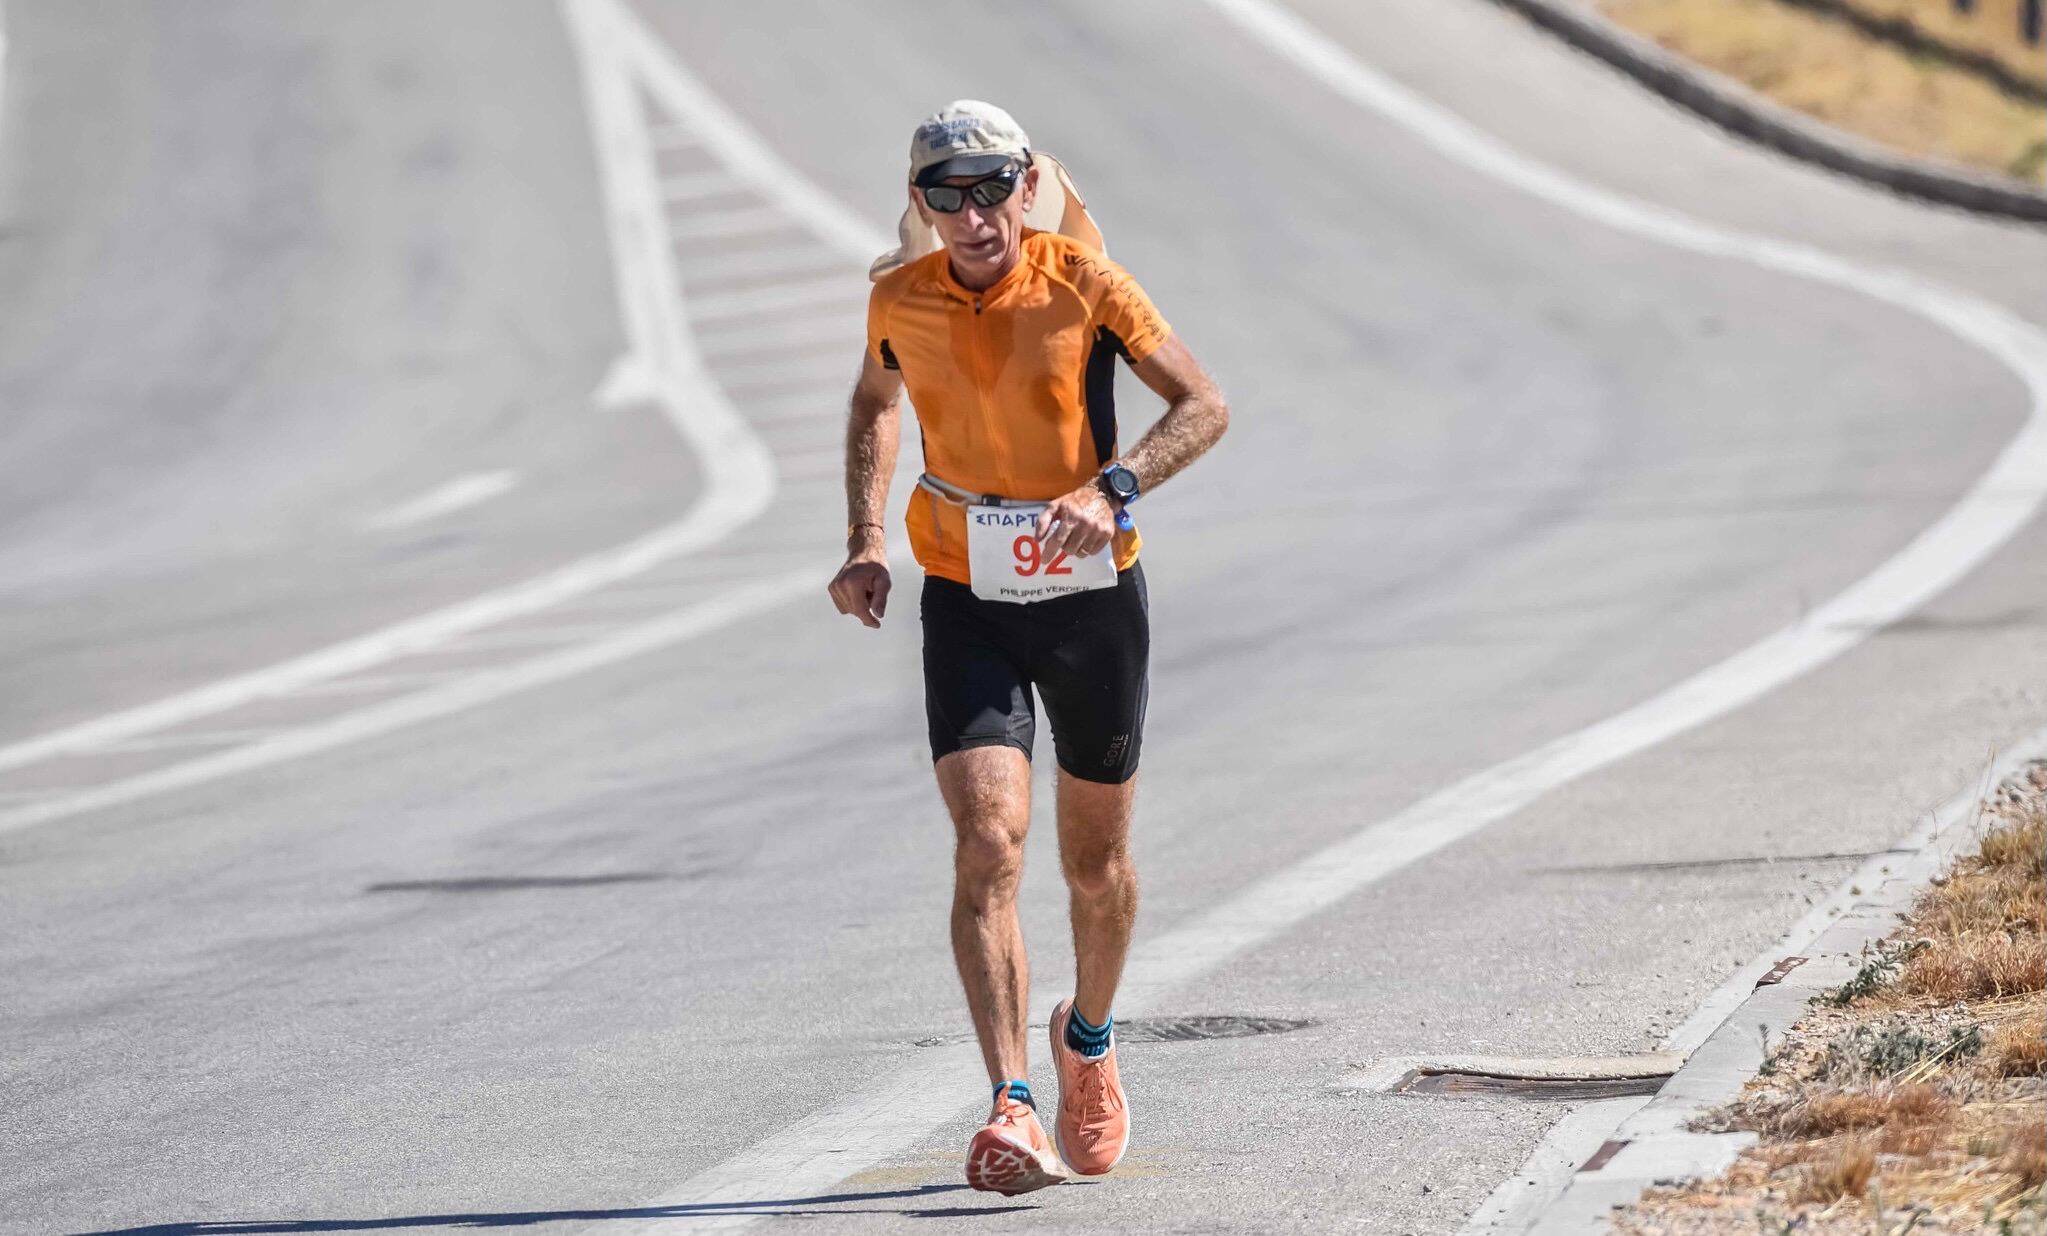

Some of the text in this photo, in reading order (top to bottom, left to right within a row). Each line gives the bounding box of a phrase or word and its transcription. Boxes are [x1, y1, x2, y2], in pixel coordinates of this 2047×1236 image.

[976, 513, 1038, 528] ΣΠΑΡΤ
[1012, 534, 1073, 577] 92
[1000, 586, 1043, 598] PHILIPPE
